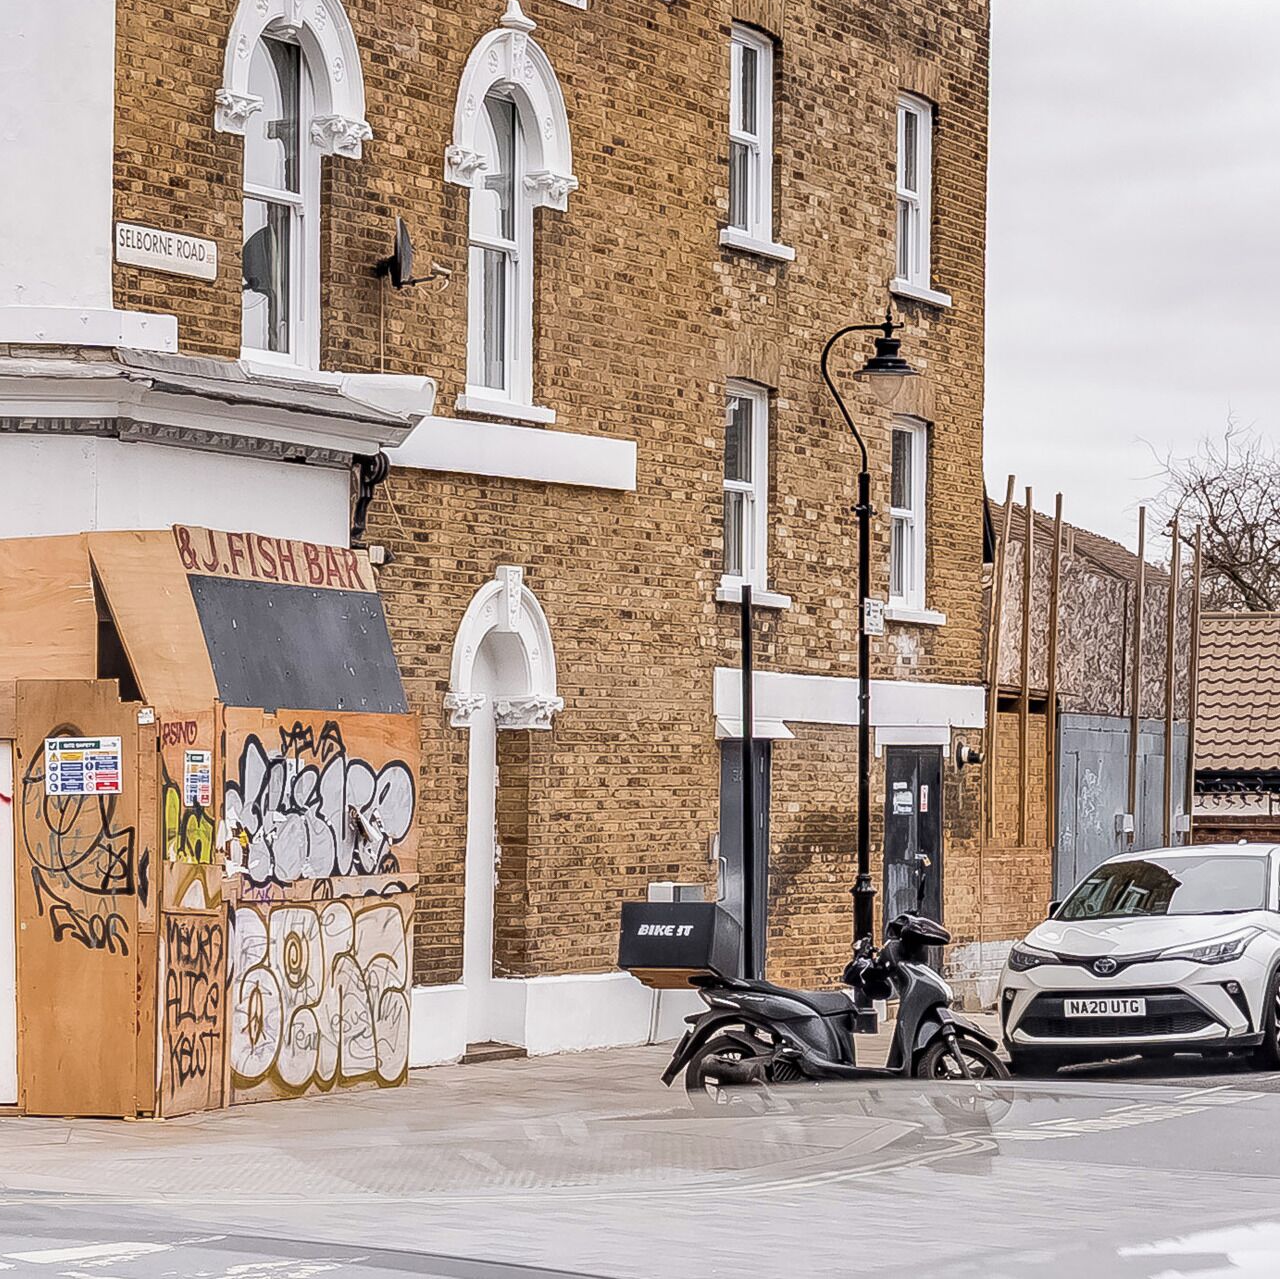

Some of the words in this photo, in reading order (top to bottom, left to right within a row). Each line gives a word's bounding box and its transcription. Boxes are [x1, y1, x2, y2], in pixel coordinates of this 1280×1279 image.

[119, 228, 173, 256] SELBORNE
[176, 239, 206, 262] ROAD
[178, 527, 201, 571] &
[303, 542, 367, 591] BAR
[637, 924, 676, 936] BIKE
[1070, 1001, 1108, 1014] NA20
[1111, 999, 1139, 1013] UTG
